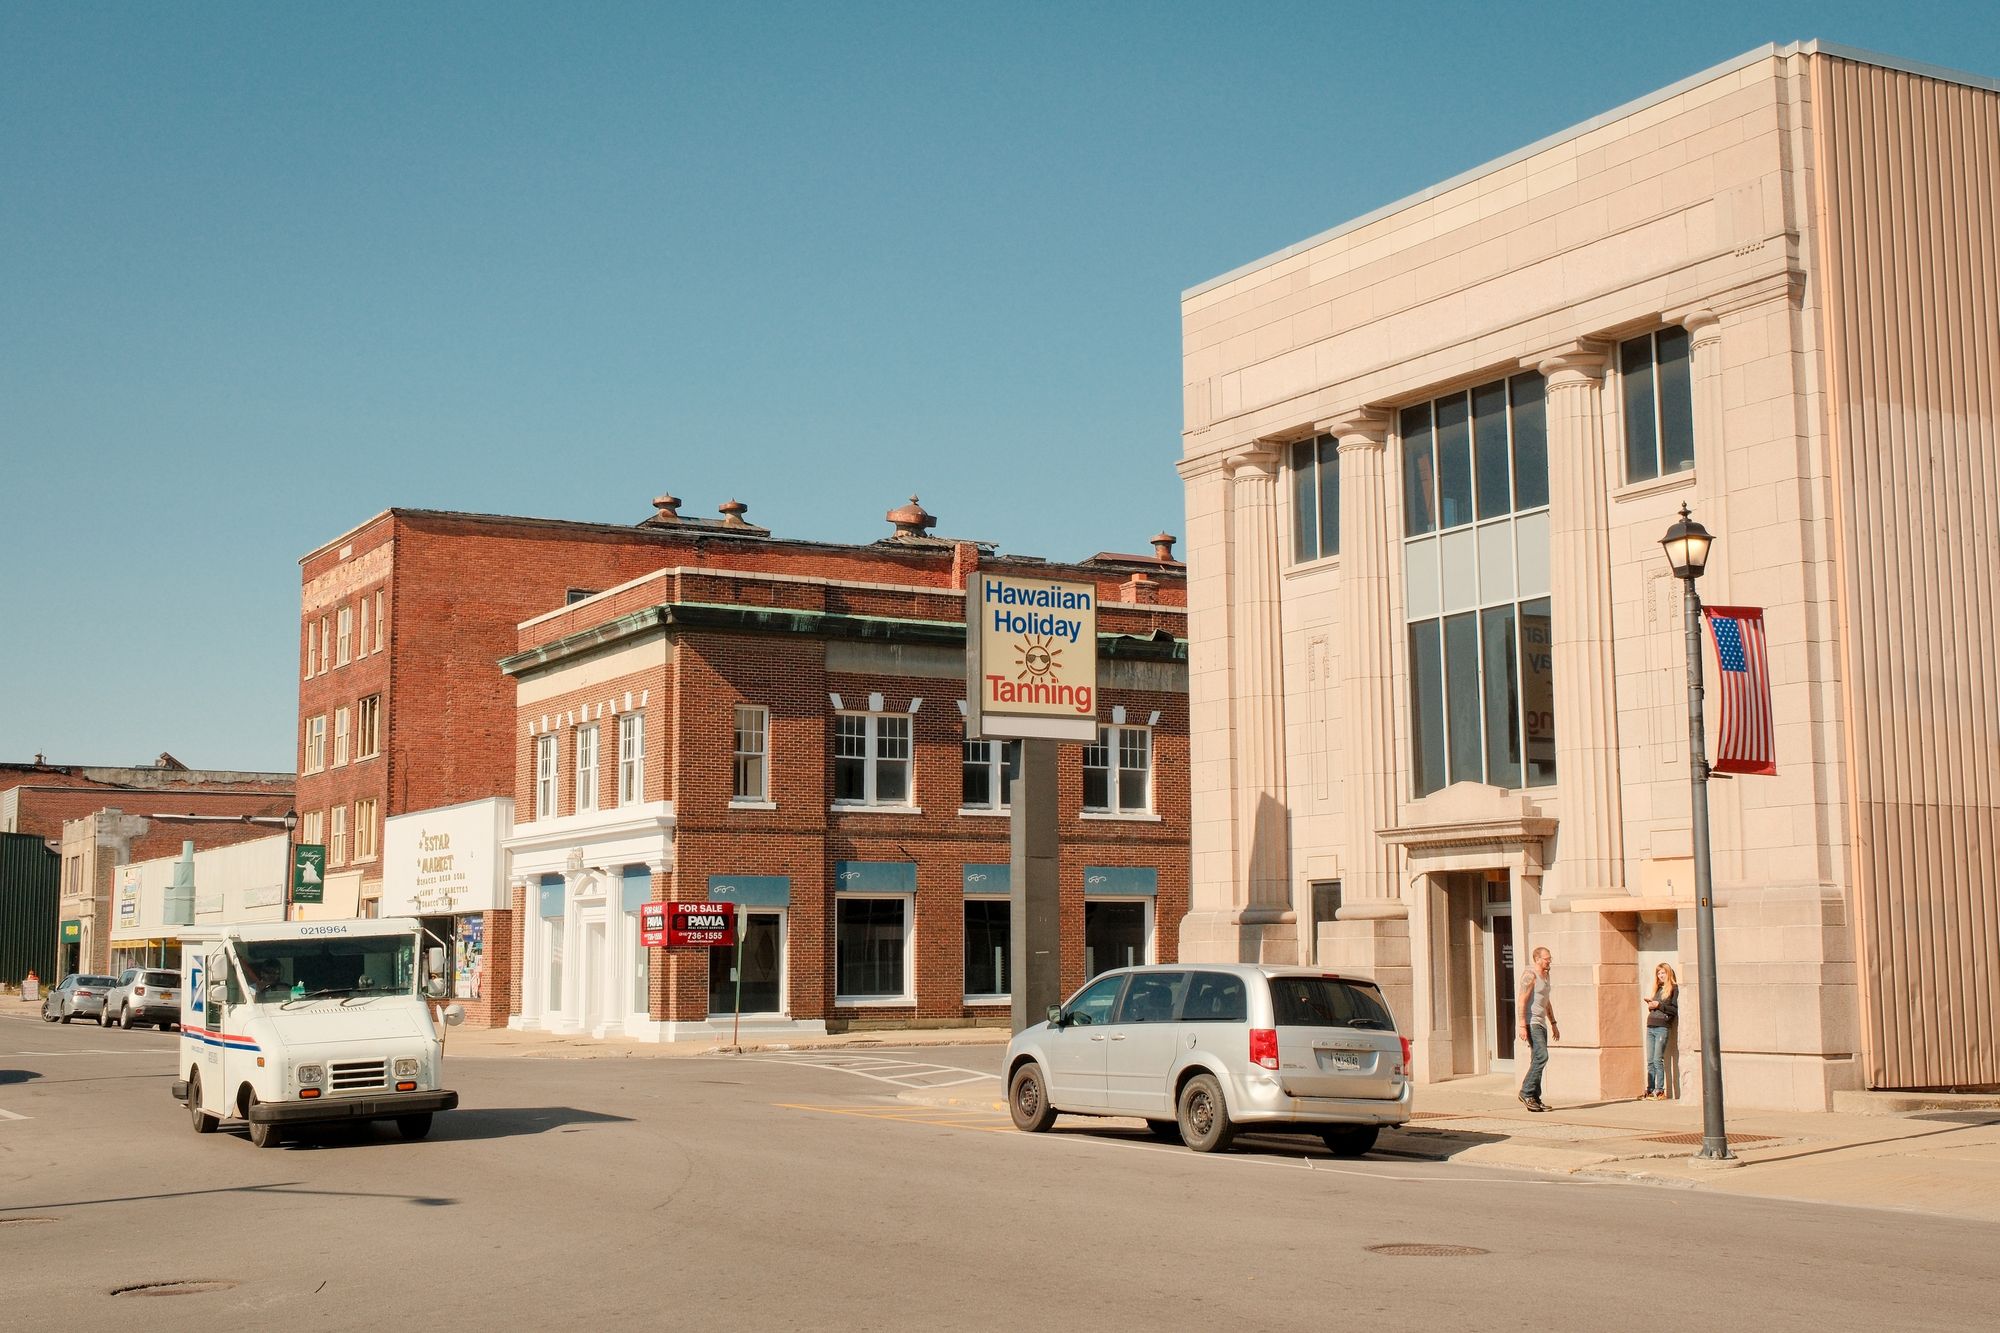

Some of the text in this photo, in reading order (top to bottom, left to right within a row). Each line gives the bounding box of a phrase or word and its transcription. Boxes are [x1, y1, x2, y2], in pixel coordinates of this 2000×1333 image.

[986, 580, 1091, 610] Hawaiian
[994, 610, 1081, 643] Holiday
[986, 674, 1092, 713] Tanning
[424, 833, 450, 852] 5STAR
[421, 854, 454, 874] MARKET
[678, 904, 723, 913] FOR SALE
[646, 915, 663, 928] PAVIA
[687, 915, 725, 927] PAVIA
[300, 925, 347, 935] 0218964
[687, 931, 723, 940] 736-1555
